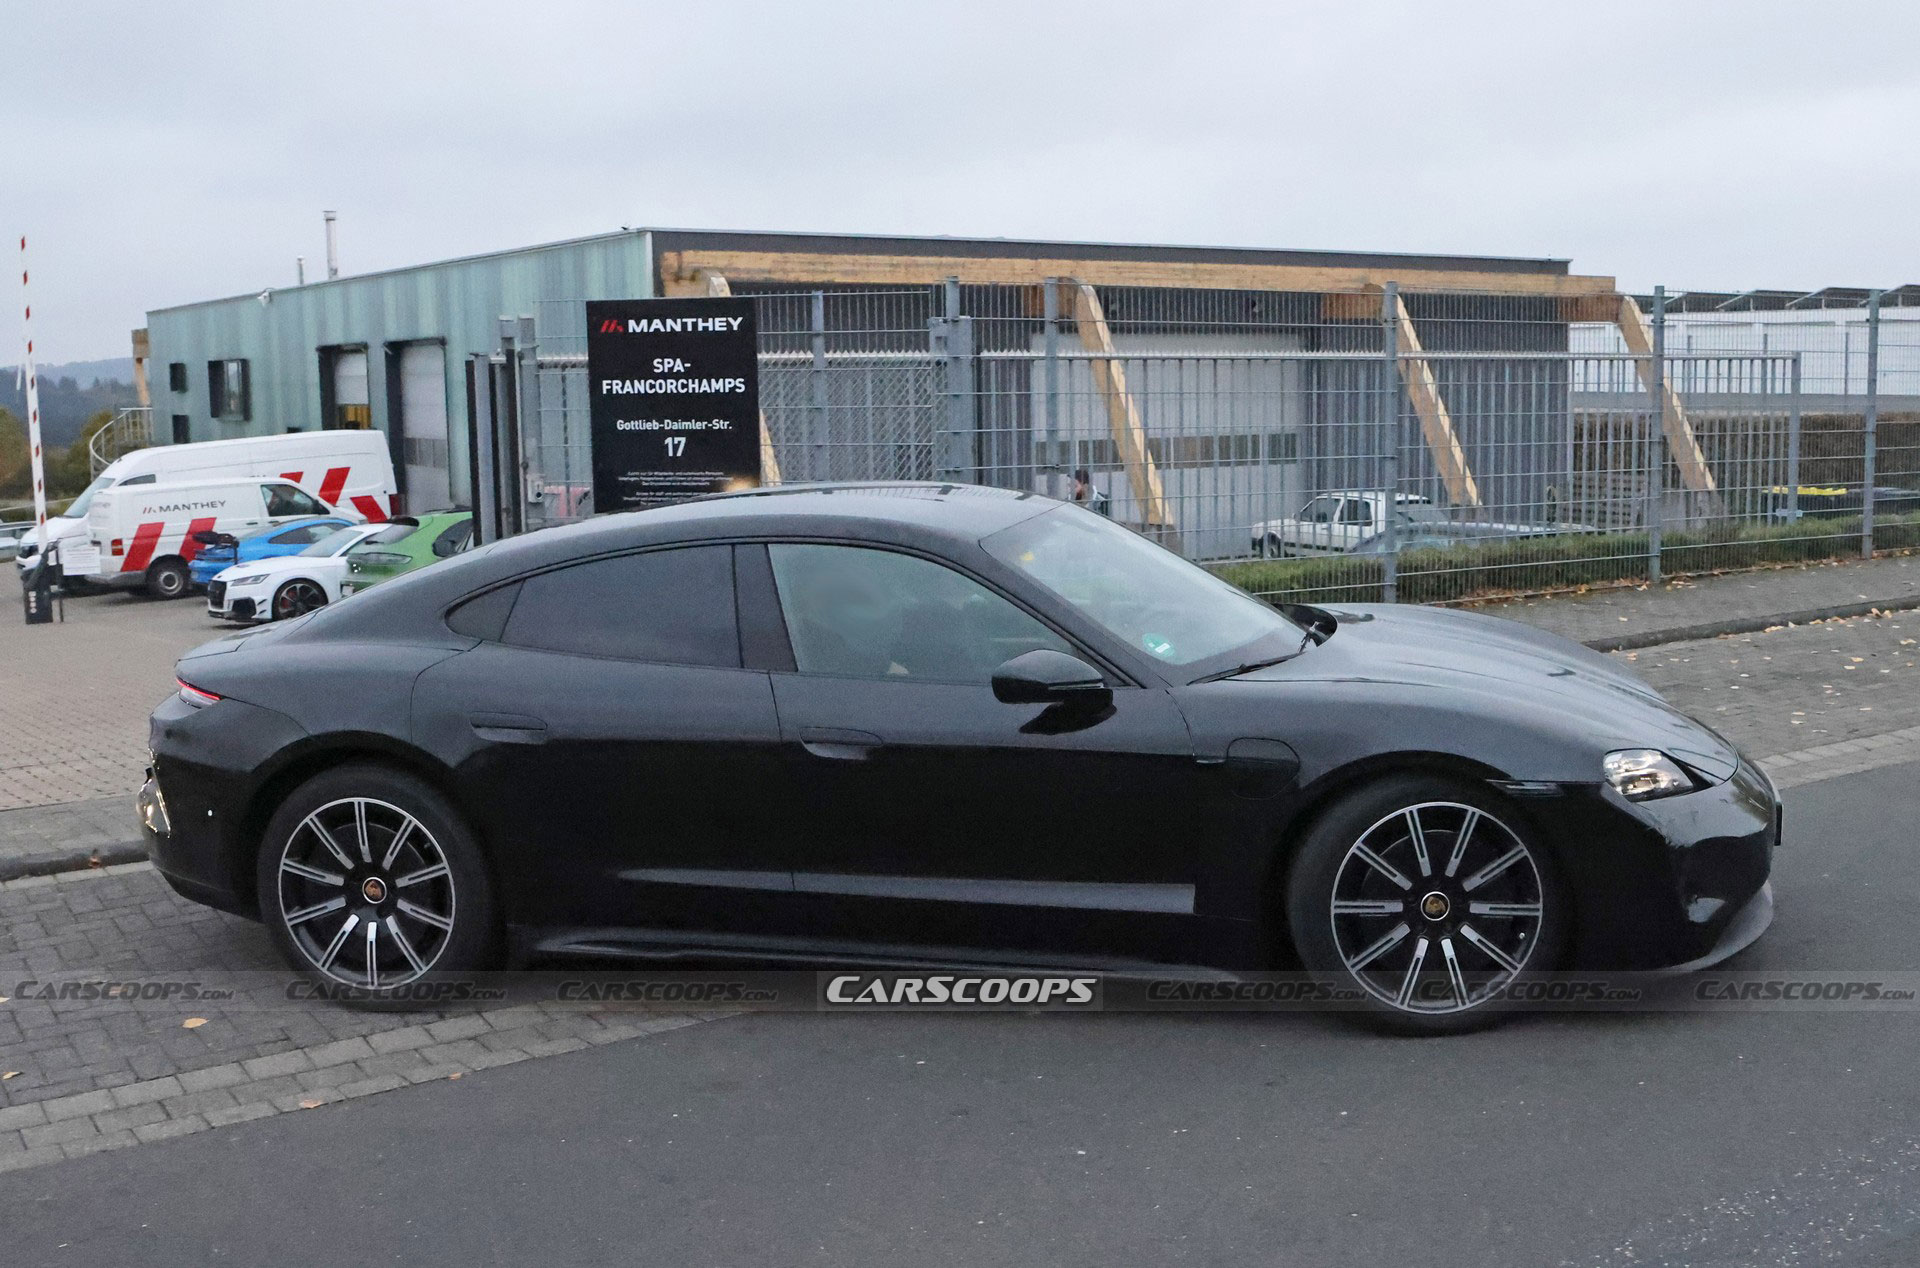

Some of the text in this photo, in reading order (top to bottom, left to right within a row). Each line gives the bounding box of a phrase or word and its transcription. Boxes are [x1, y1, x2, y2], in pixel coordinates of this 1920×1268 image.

[628, 317, 744, 333] MANTHEY
[653, 358, 691, 373] SPA-
[602, 378, 746, 394] FRANCORCHAMPS
[616, 419, 733, 431] Gottlieb-Daimler-Str.
[664, 436, 686, 457] 17
[159, 500, 226, 512] MANTHEY
